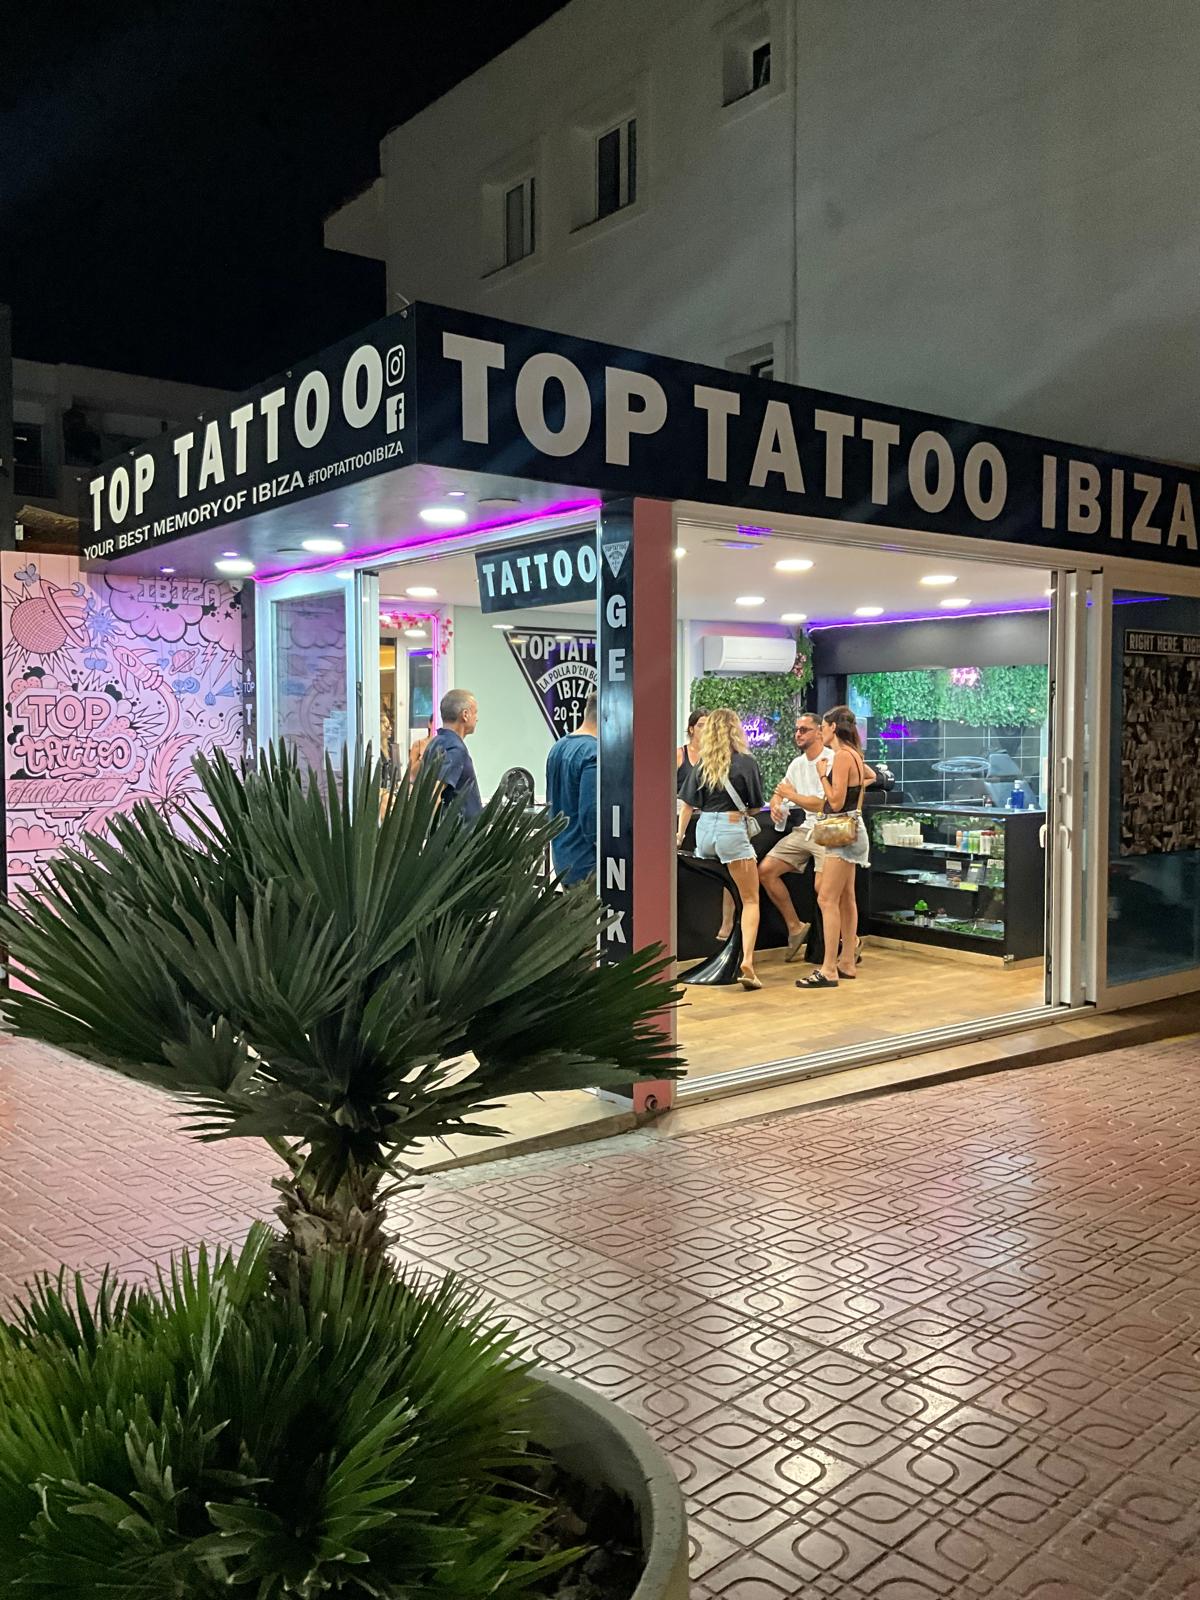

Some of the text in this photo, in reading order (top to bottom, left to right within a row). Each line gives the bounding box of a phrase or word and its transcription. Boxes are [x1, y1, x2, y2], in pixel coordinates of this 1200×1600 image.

[90, 345, 383, 532] TOP TATTOO
[442, 332, 1199, 550] TOP TATTOO IBIZA
[84, 441, 404, 560] YOUR BEST MEMORY OF IBIZA #TOPTATTOOIBIZA
[482, 545, 597, 597] TATTOO
[137, 577, 221, 607] IBIZA
[606, 594, 627, 682] GE
[1129, 633, 1154, 651] RIGHT
[243, 682, 255, 693] TOP
[540, 679, 549, 690] LA
[549, 665, 571, 682] POLLA
[572, 665, 589, 677] D'EN
[557, 679, 594, 700] IBIZA
[17, 694, 112, 737] TOP
[553, 706, 567, 721] 20
